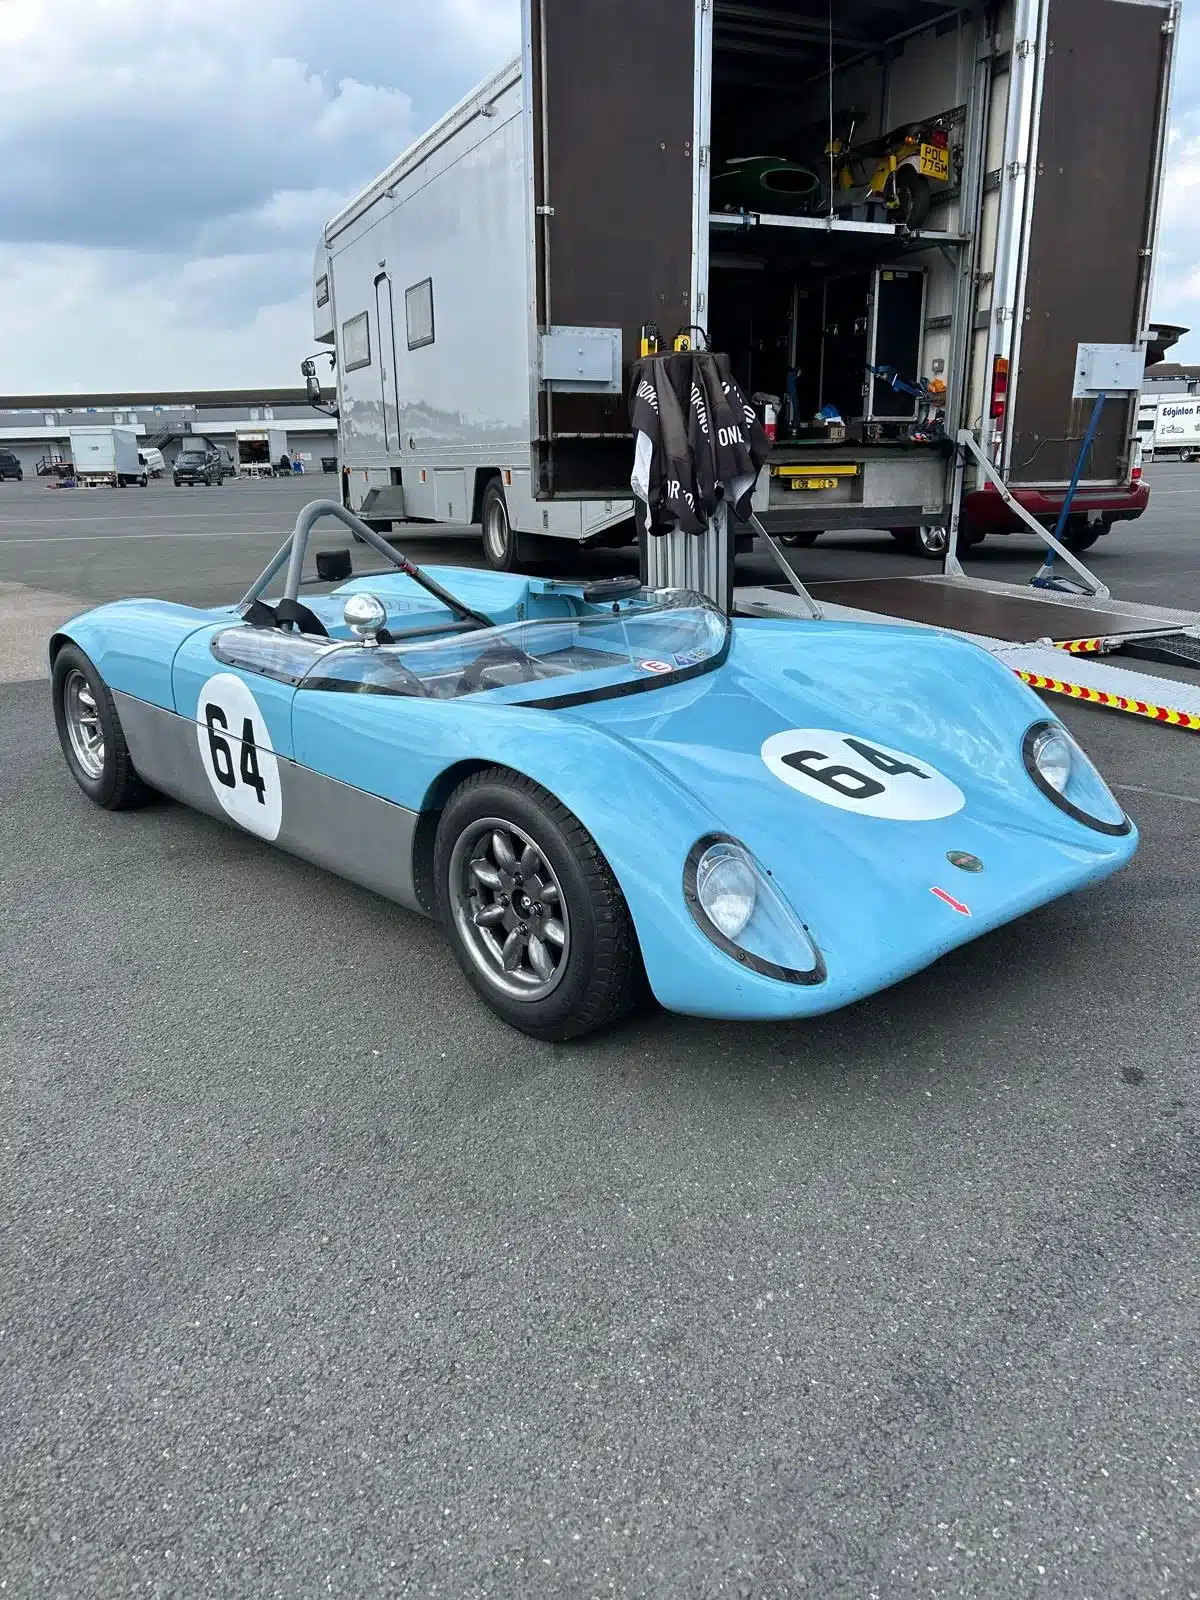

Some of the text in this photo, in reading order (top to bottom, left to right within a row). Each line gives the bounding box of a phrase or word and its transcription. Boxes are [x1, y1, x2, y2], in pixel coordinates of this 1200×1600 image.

[922, 157, 948, 175] 775M
[1163, 406, 1193, 418] Edginton
[205, 703, 267, 805] 64
[780, 738, 932, 799] 64
